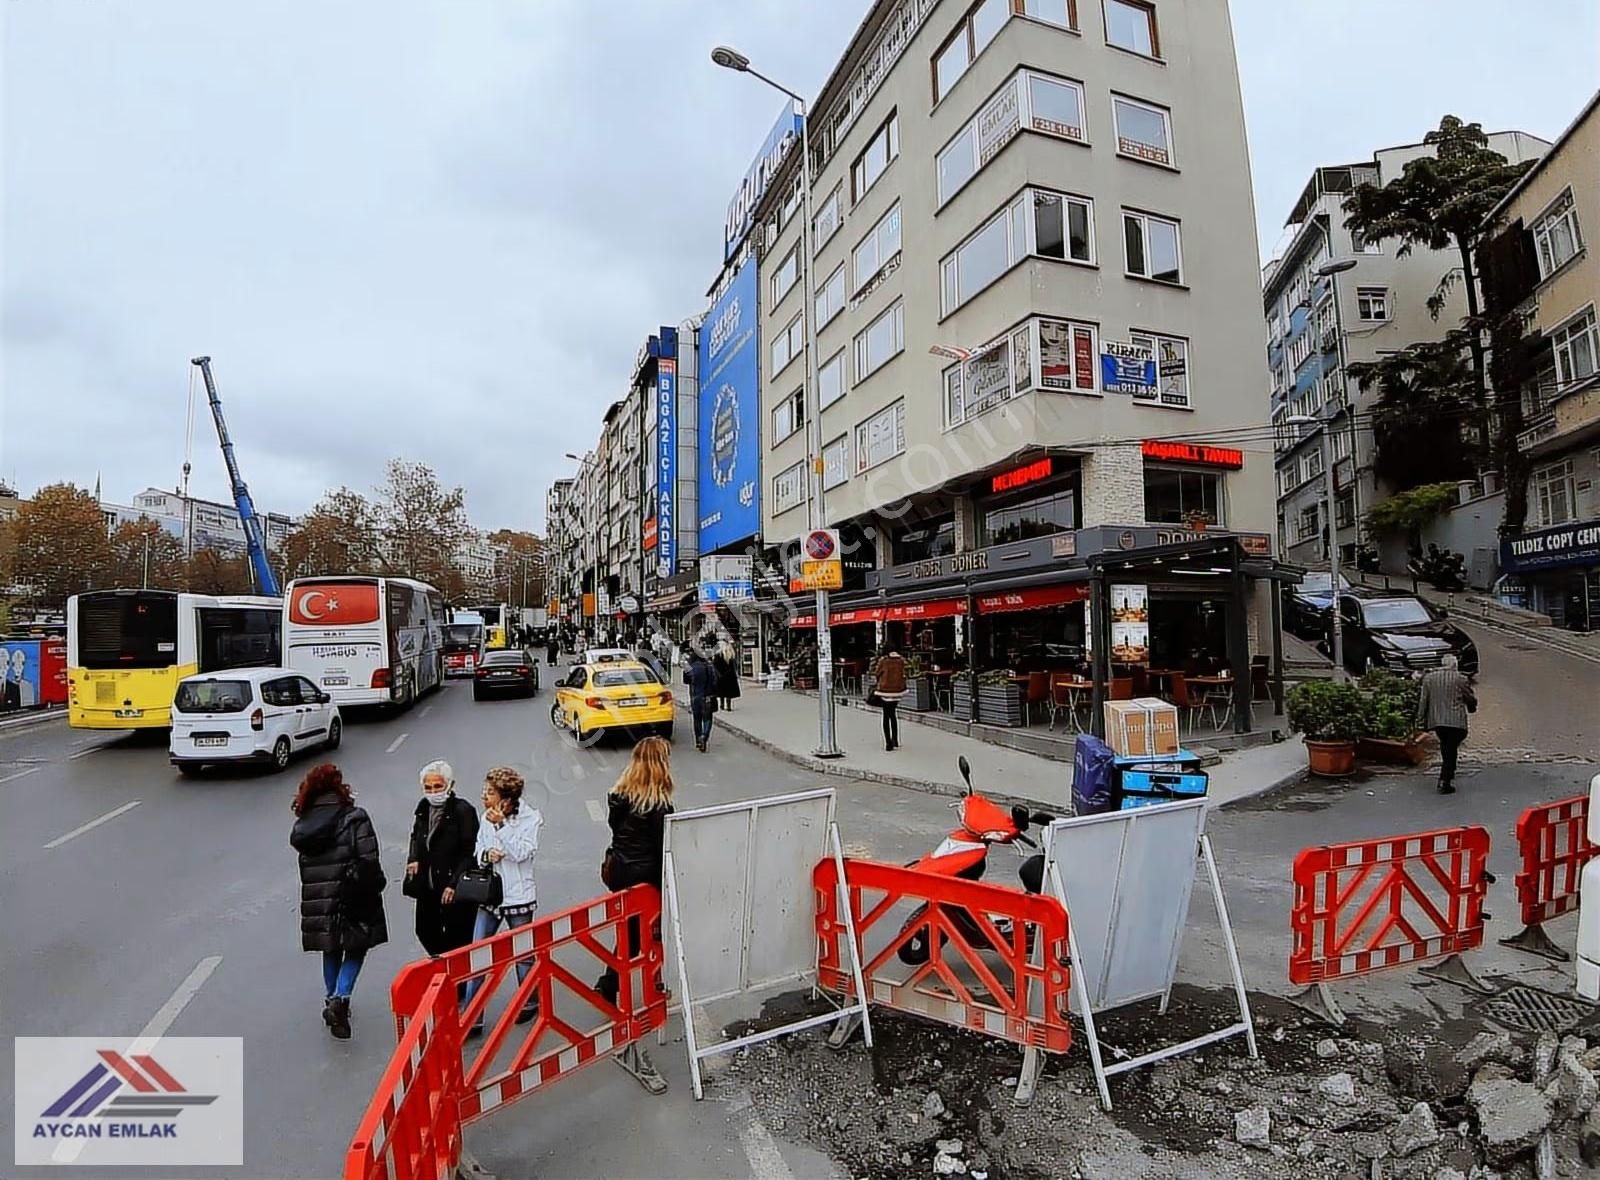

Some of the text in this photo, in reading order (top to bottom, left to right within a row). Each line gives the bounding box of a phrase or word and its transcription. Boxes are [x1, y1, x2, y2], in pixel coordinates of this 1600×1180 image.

[992, 458, 1051, 493] MENEMEN
[660, 491, 671, 576] AKADEM
[1511, 537, 1543, 555] YILDIZ
[1546, 531, 1574, 550] COPY
